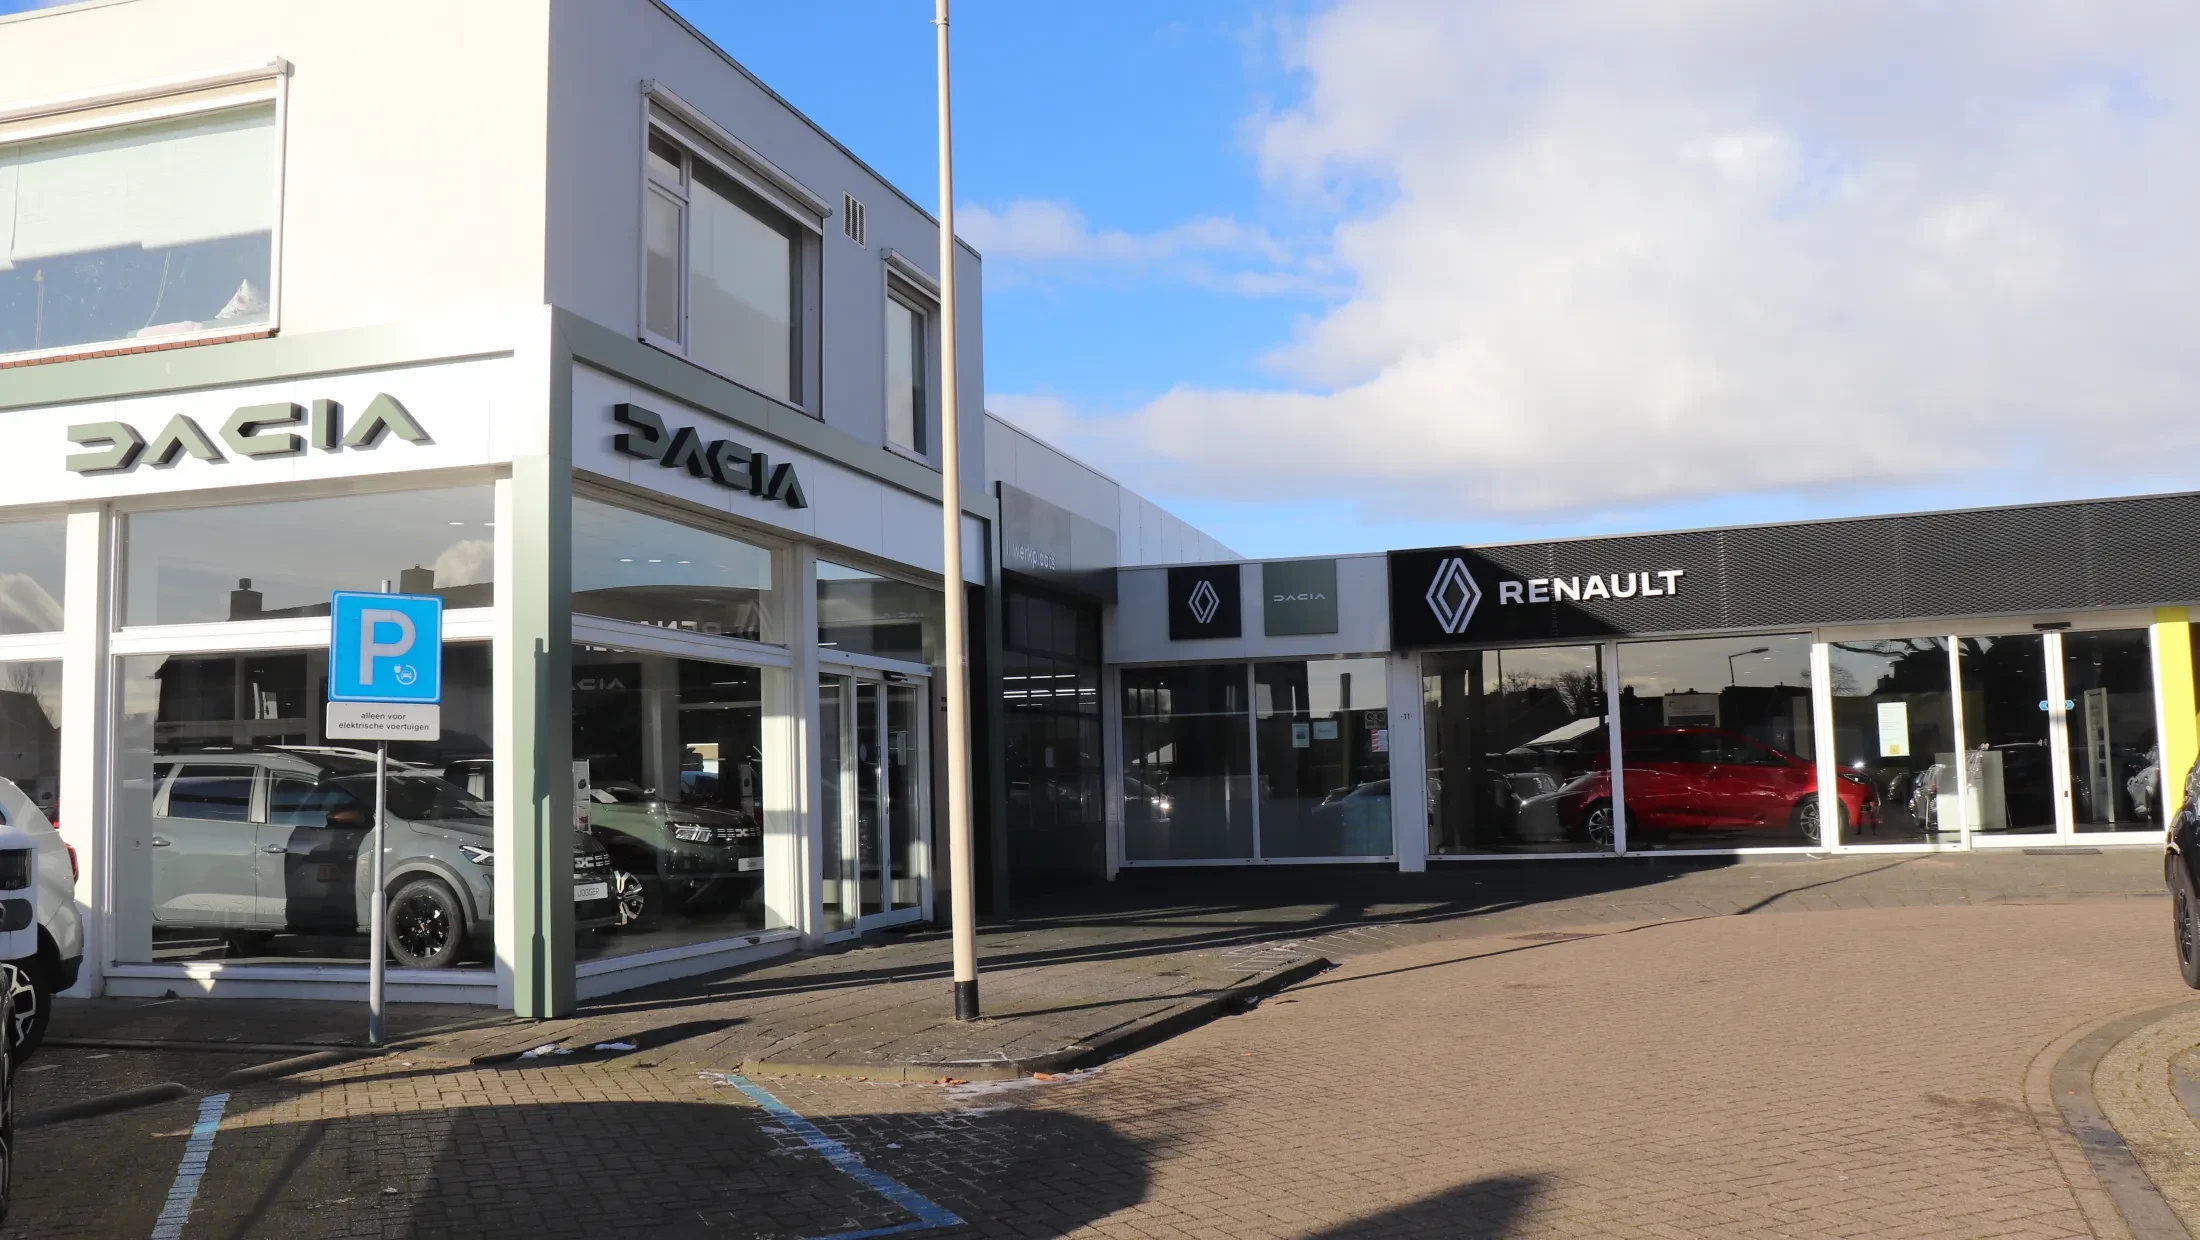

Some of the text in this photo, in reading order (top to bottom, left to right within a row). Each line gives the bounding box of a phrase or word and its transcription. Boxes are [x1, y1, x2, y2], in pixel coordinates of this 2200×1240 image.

[65, 391, 434, 473] DACIA
[614, 402, 809, 509] DACIA
[1273, 592, 1326, 602] DACIA
[1499, 569, 1684, 605] RENAULT
[358, 608, 416, 686] P
[338, 721, 430, 732] elektrische voertuigen
[360, 712, 406, 721] alleen voor
[577, 887, 600, 898] JOGGER
